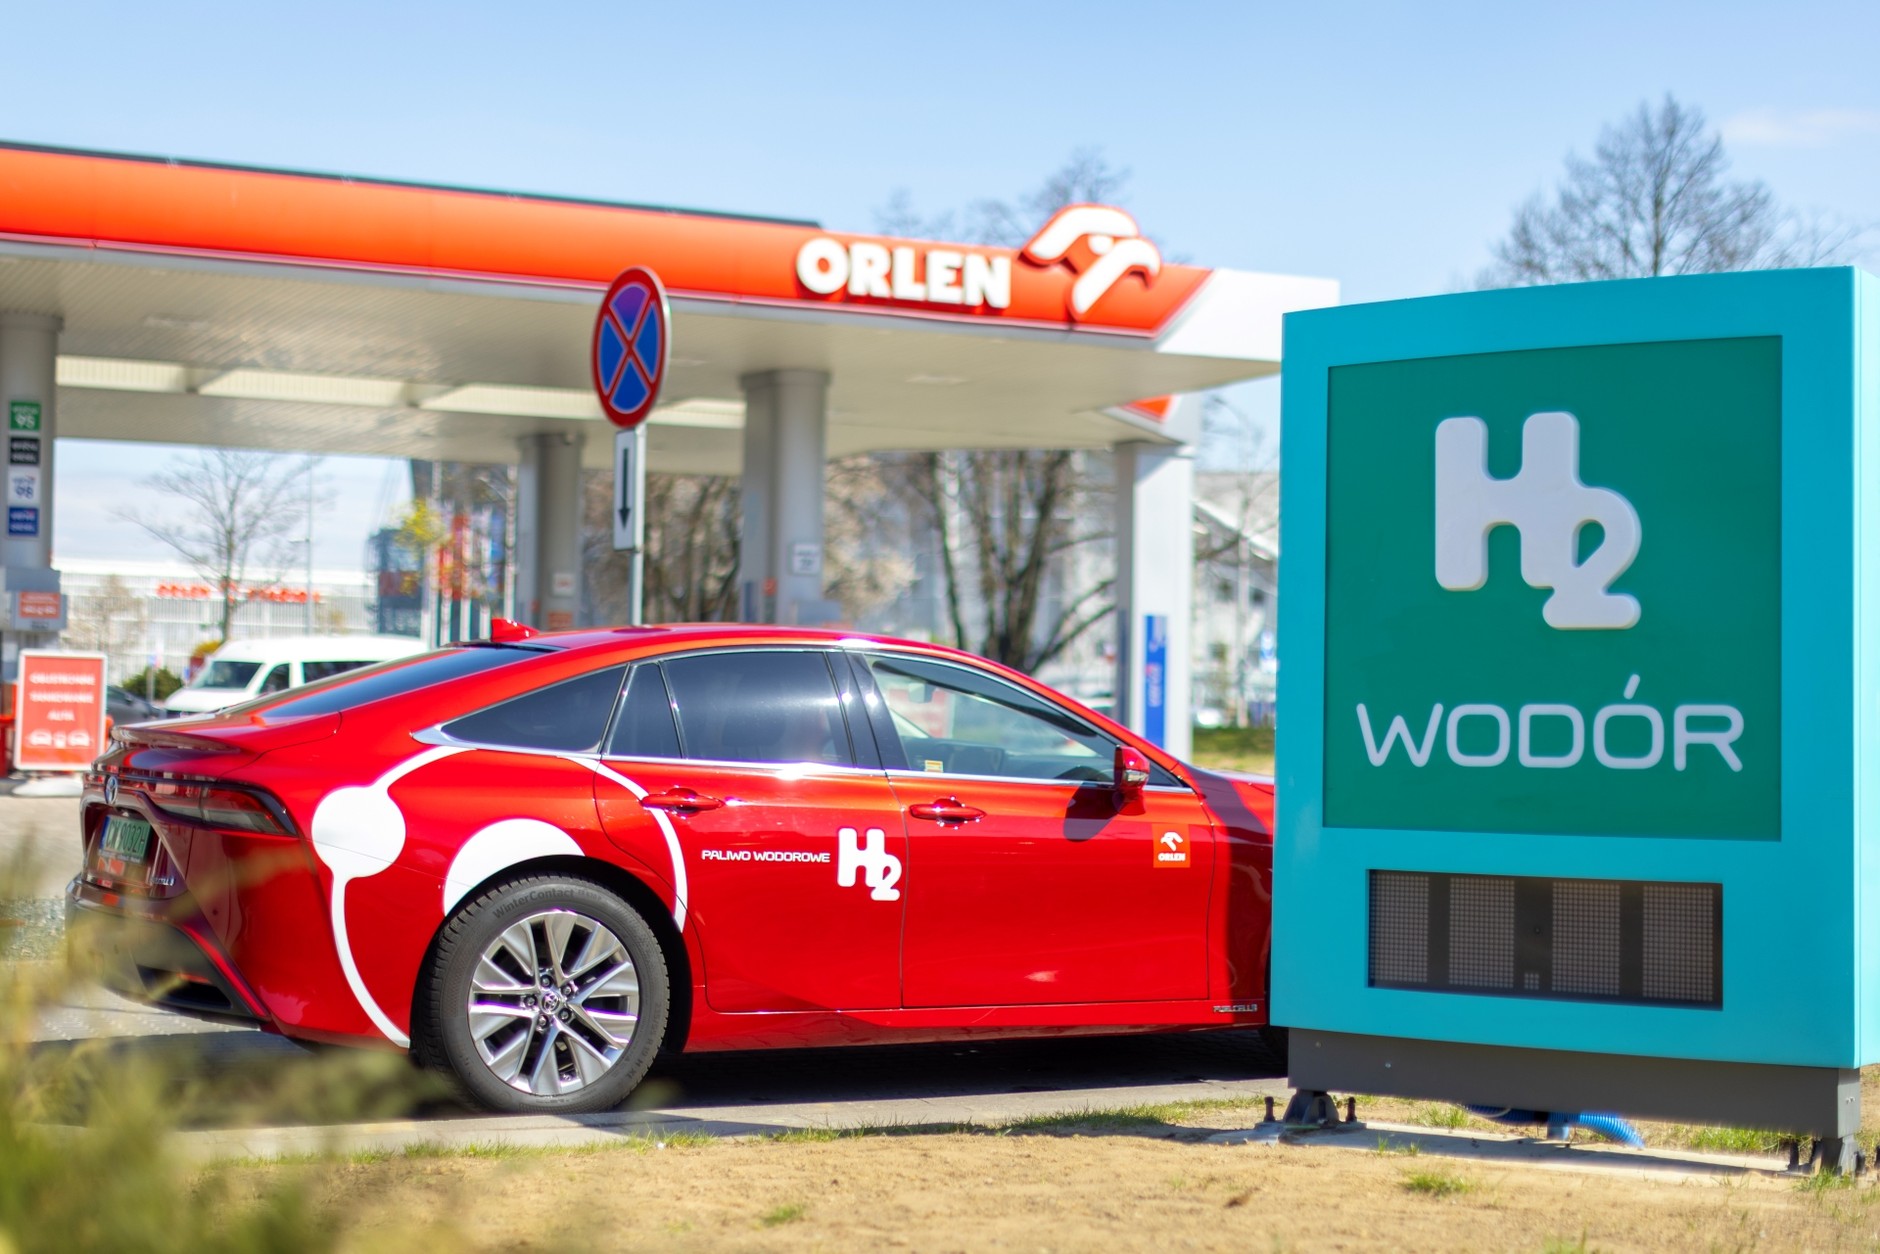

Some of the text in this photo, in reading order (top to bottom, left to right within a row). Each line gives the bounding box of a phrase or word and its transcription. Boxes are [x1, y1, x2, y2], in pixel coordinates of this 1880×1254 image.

[797, 238, 1011, 309] ORLEN
[1435, 411, 1642, 630] H2
[1356, 674, 1744, 772] WODÓR
[702, 827, 902, 901] PALIWO WODOROWE H2
[1158, 852, 1186, 862] ORLEN
[492, 888, 574, 918] WinterContact
